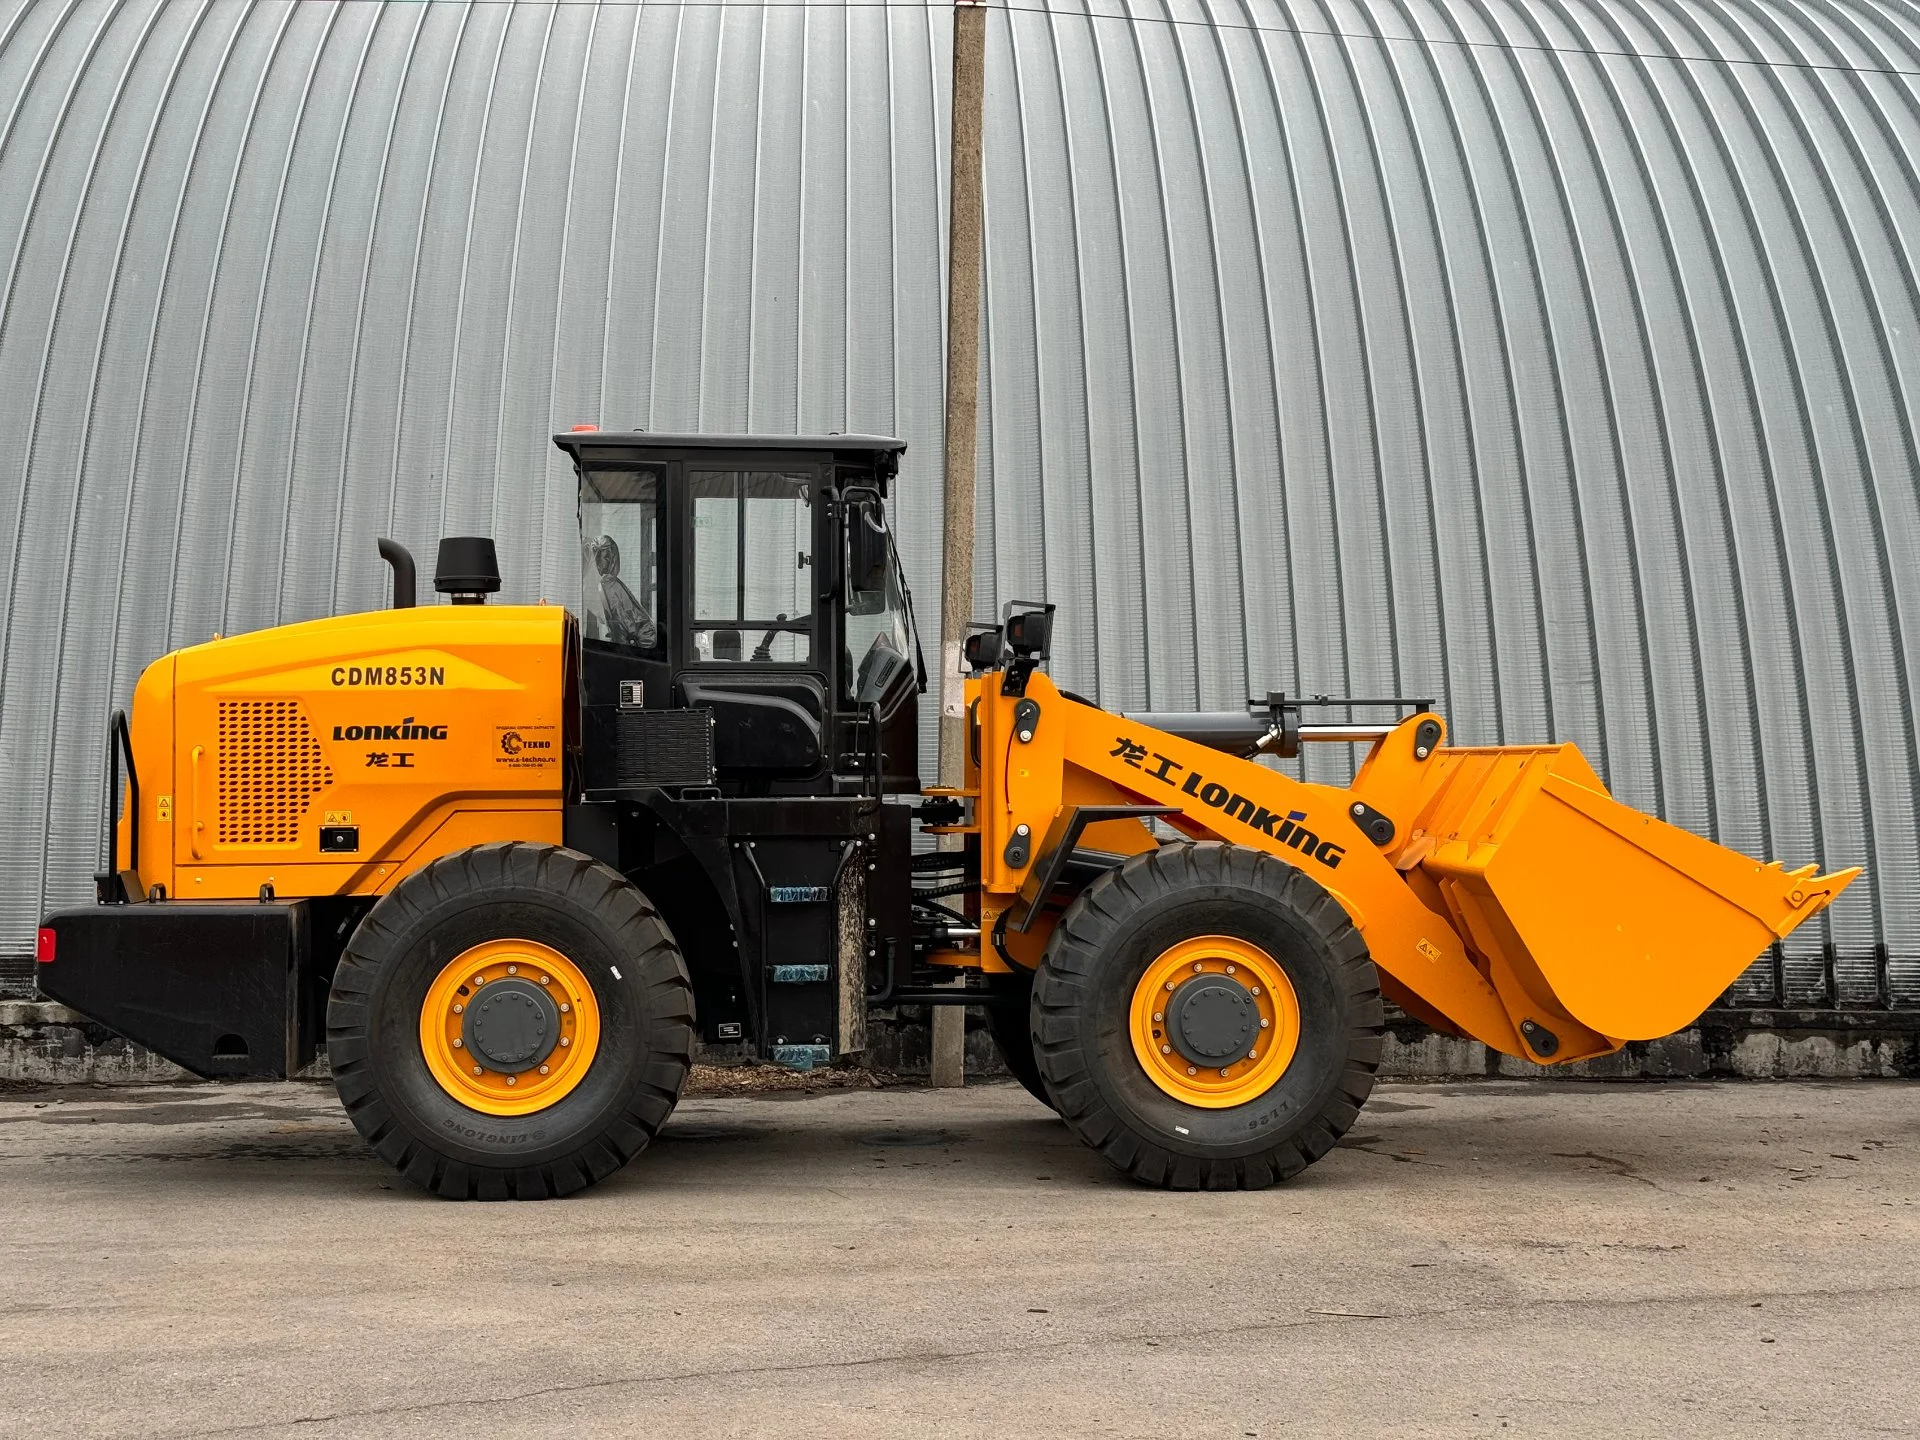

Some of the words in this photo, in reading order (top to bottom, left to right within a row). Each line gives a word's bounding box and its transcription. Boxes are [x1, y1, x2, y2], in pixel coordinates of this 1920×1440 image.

[331, 667, 445, 686] CDM853N
[333, 717, 448, 741] LONKING
[365, 752, 415, 768] 龙工
[1109, 737, 1183, 786] 龙工
[1181, 772, 1346, 870] LONKING
[442, 1118, 528, 1144] LINGLONG
